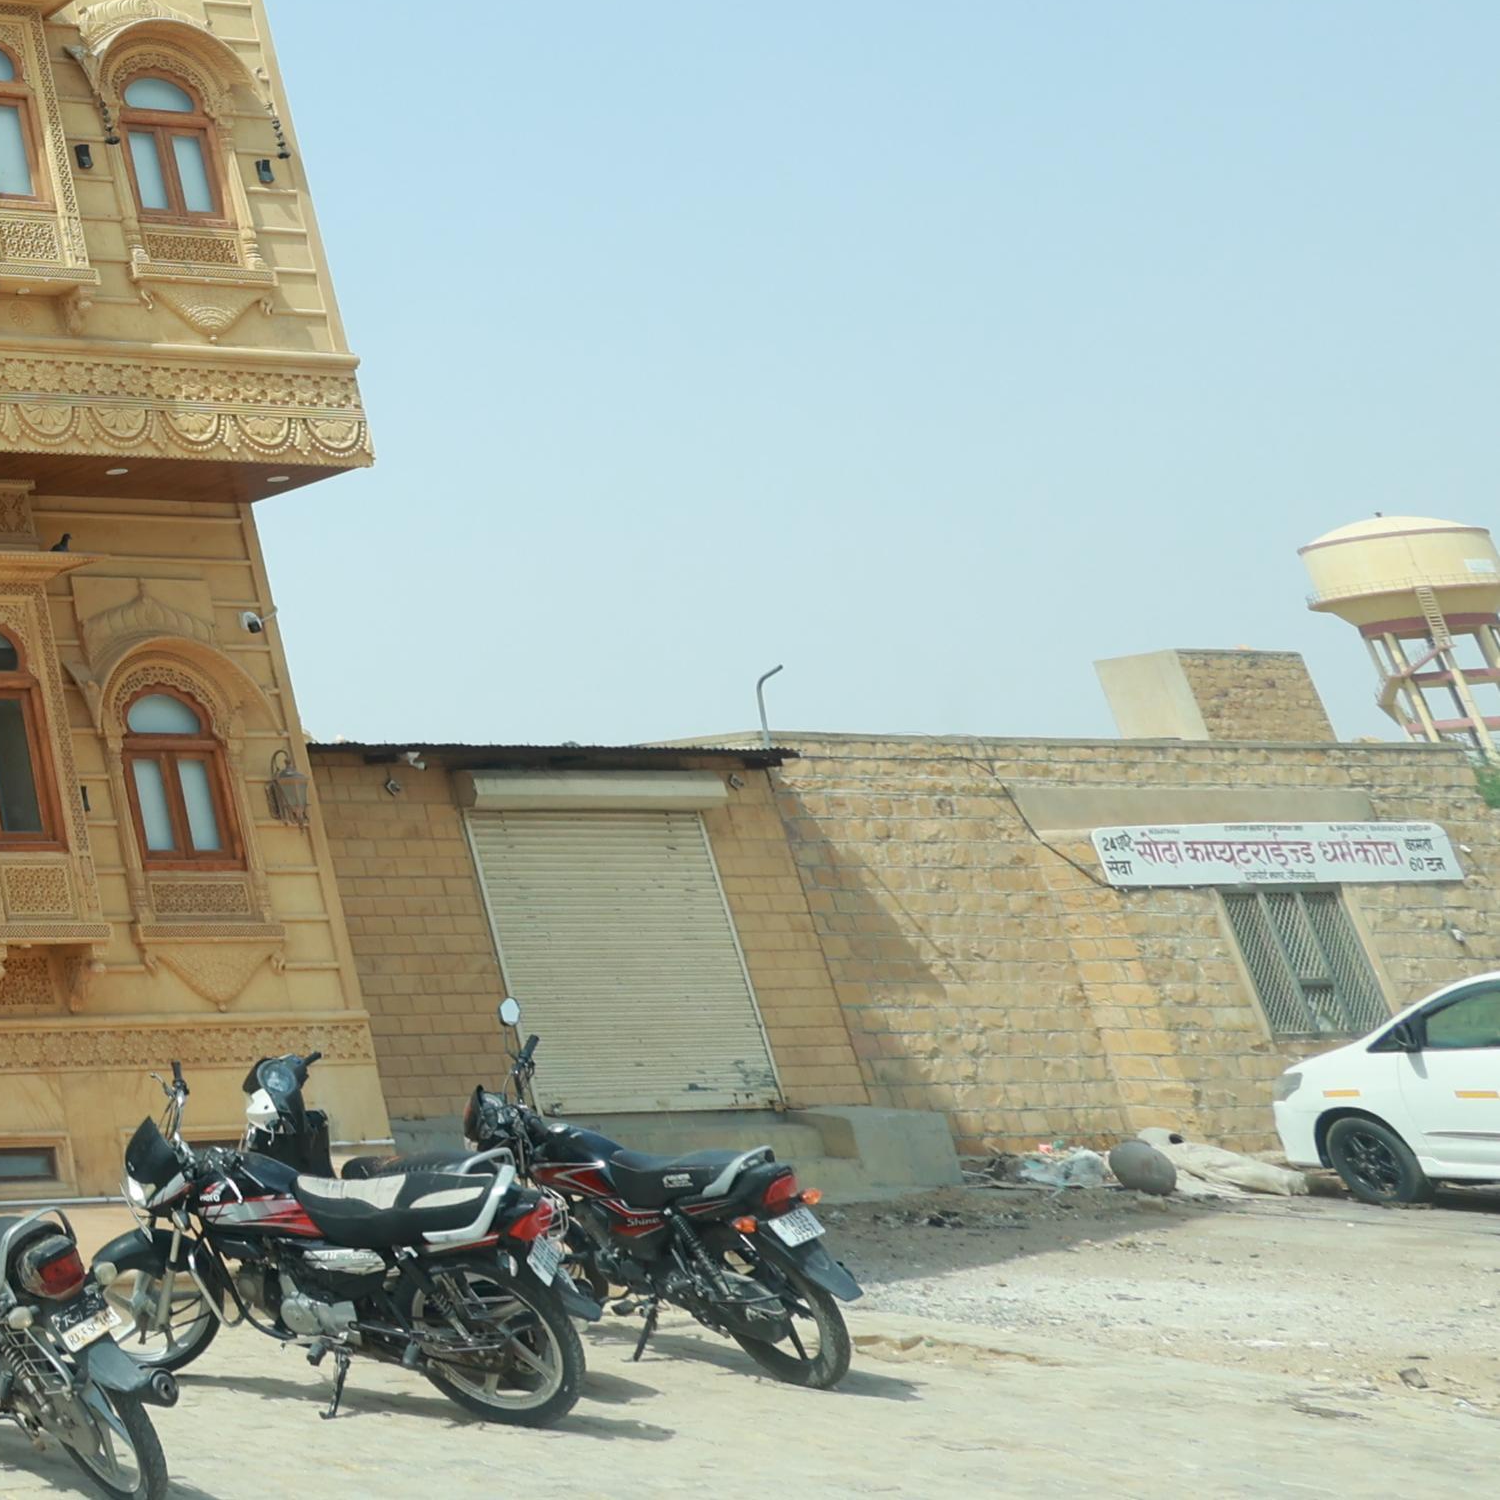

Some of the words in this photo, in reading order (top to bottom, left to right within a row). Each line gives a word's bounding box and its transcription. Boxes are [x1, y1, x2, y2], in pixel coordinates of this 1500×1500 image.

[1105, 855, 1133, 877] सेवा
[1409, 857, 1424, 871] 60
[1423, 857, 1447, 871] टन
